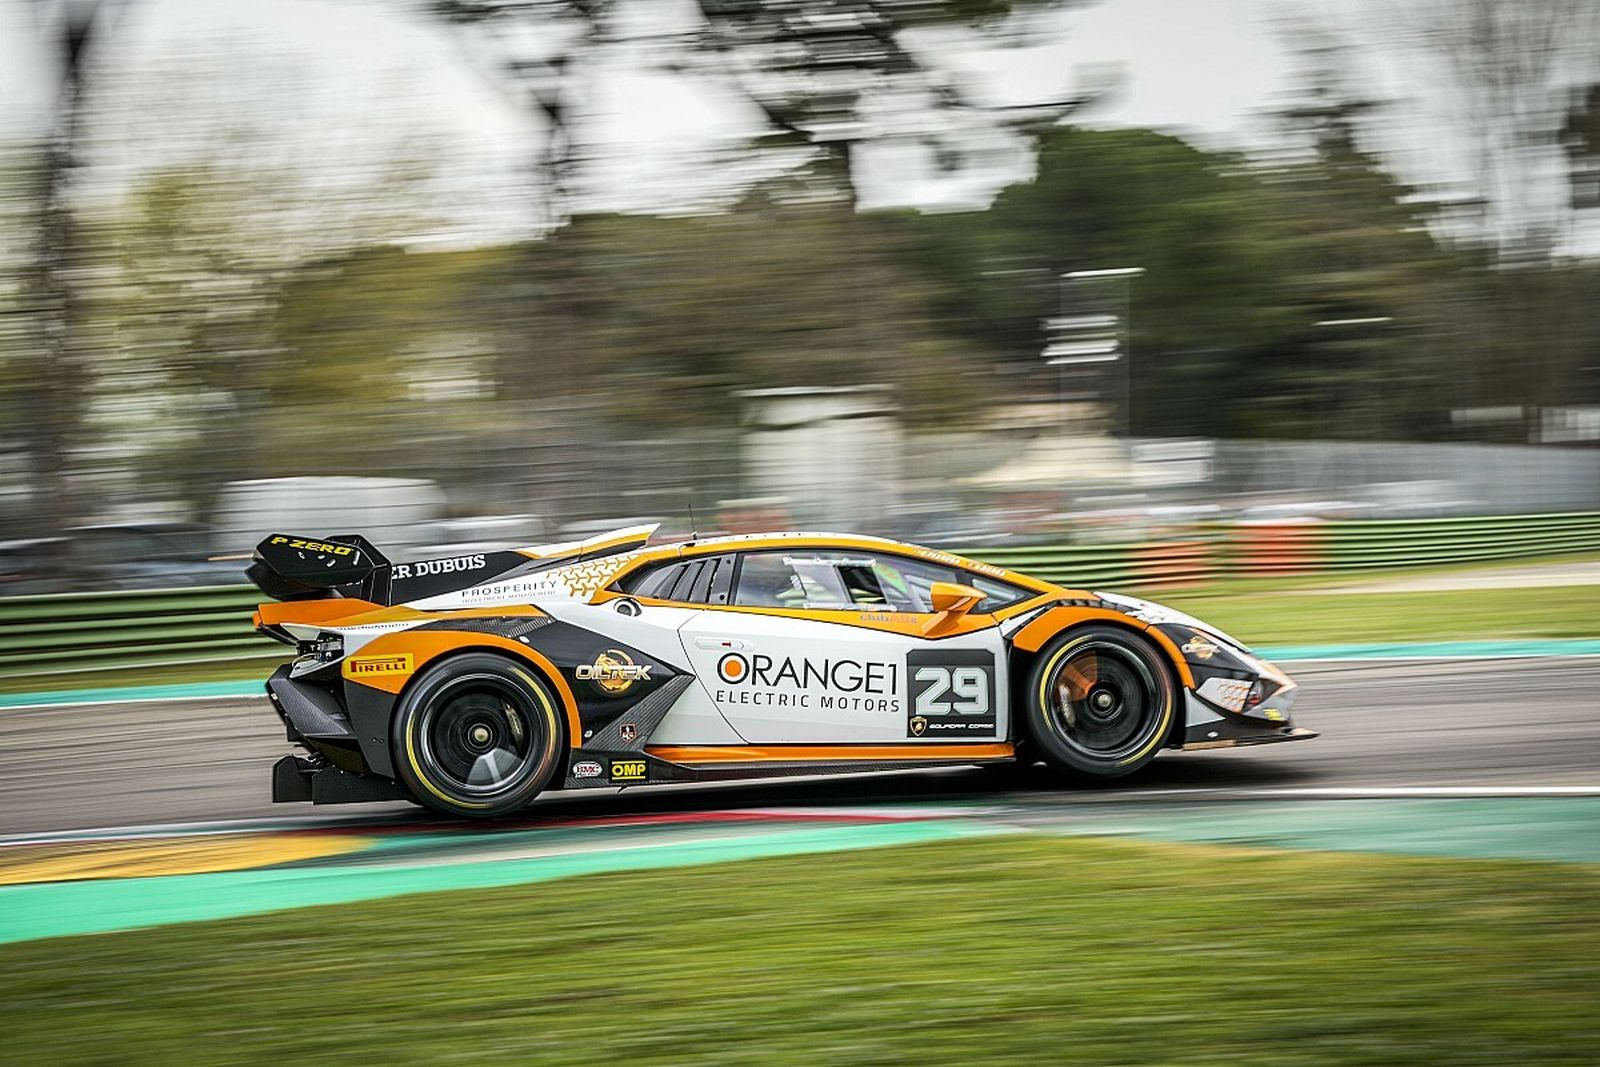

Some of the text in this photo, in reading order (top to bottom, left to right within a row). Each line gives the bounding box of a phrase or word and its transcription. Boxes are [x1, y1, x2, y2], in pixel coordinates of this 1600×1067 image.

[271, 536, 353, 556] P ZERO
[414, 554, 486, 577] DUBUIS
[462, 580, 557, 597] PROSPERITY
[351, 657, 406, 673] PIRELLI
[575, 664, 652, 681] OILTEK
[717, 652, 898, 695] ORANGE1
[716, 690, 899, 713] ELECTRIC MOTORS
[914, 667, 989, 716] 29
[611, 764, 646, 777] OMP
